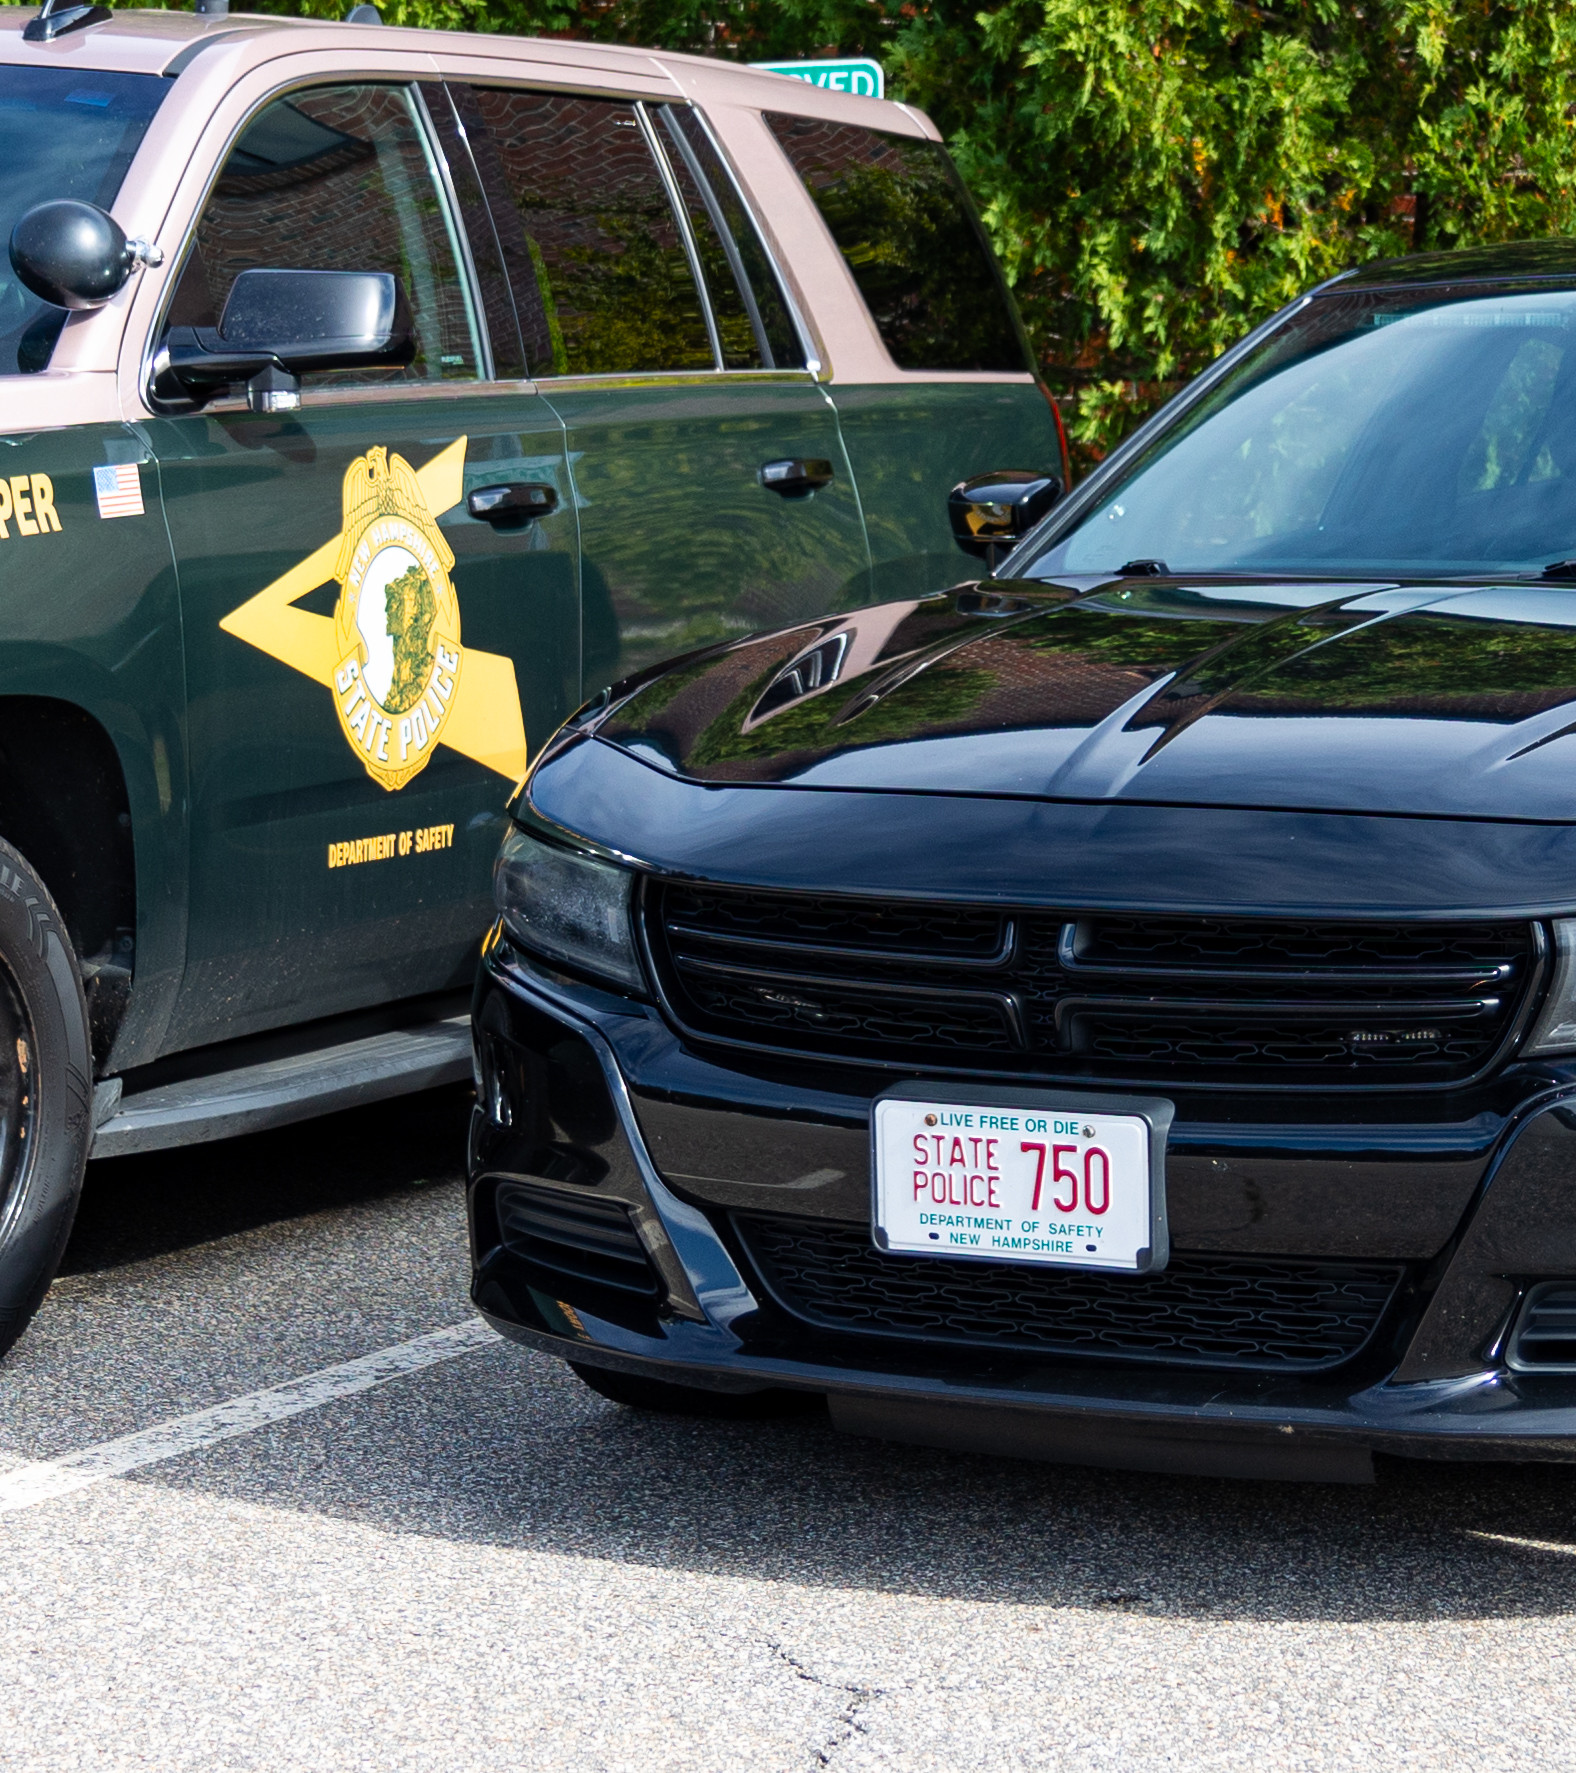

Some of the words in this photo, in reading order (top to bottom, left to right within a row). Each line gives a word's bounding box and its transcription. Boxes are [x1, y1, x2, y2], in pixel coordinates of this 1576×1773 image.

[349, 539, 371, 587] NEW
[371, 521, 440, 581] HAMPSHIRE
[337, 659, 394, 762] STATE
[400, 644, 460, 762] POLICE
[328, 833, 396, 869] DEPARTMENT
[398, 831, 413, 856] OF
[415, 823, 455, 853] SAFETY
[940, 1112, 973, 1128] LIVE
[979, 1115, 1019, 1131] FREE
[1025, 1118, 1047, 1133] OR
[1054, 1120, 1079, 1135] DIE
[913, 1133, 999, 1171] STATE
[1020, 1141, 1110, 1215] 750
[913, 1170, 1000, 1208] POLICE
[919, 1213, 1012, 1231] DEPARTMENT
[1021, 1220, 1040, 1233] OF
[1048, 1223, 1104, 1238] SAFETY
[949, 1232, 981, 1246] NEW
[991, 1235, 1073, 1253] HAMPSHIRE
